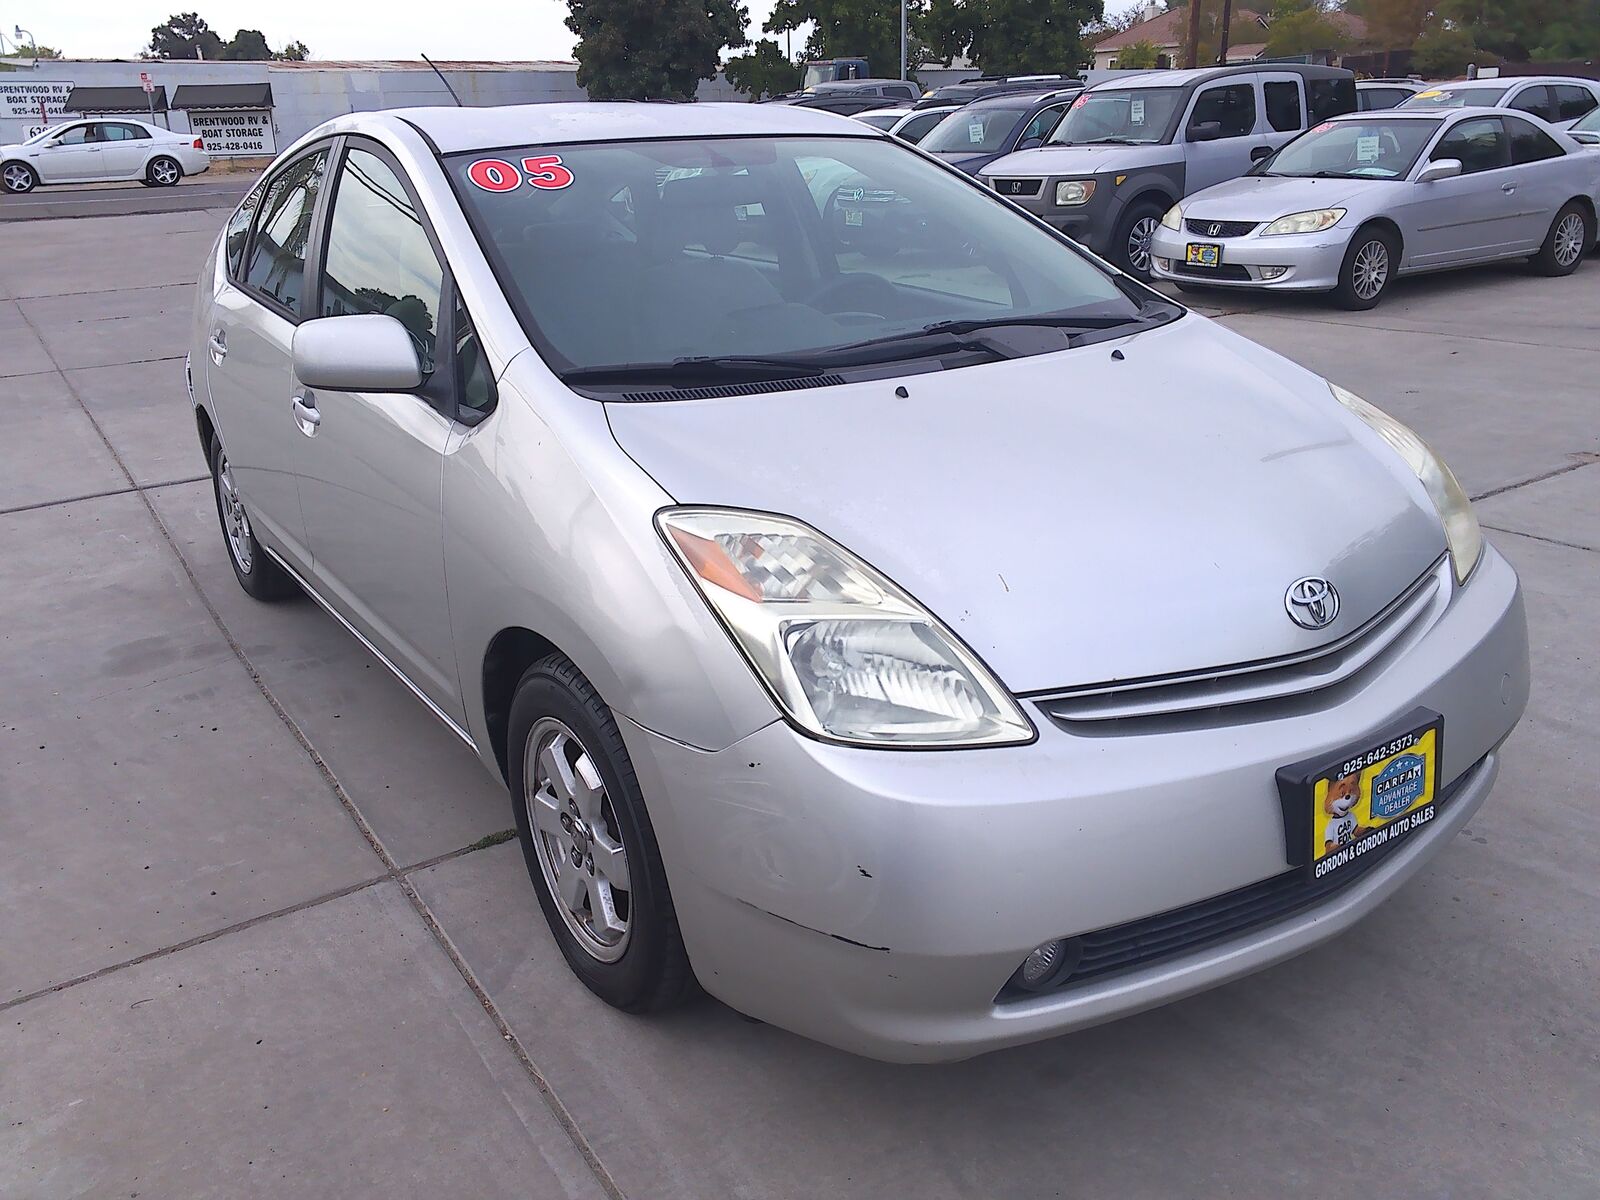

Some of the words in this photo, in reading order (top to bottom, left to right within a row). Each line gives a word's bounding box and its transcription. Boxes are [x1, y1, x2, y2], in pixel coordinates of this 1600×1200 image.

[0, 85, 50, 94] BRENTWOOD
[52, 86, 63, 94] RV
[6, 96, 28, 104] BOAT
[31, 96, 67, 104] STORAGE
[193, 116, 245, 127] BRENTWOOD
[248, 115, 259, 125] RV
[262, 115, 269, 125] &
[202, 129, 223, 138] BOAT
[226, 128, 264, 137] STORAGE
[467, 155, 575, 193] 05
[1343, 734, 1413, 775] 925-642-5373
[1377, 764, 1422, 794] CARFAX
[1378, 781, 1418, 807] ADVANTAGE
[1384, 795, 1411, 815] DEALER
[1338, 820, 1352, 836] CAR
[1315, 849, 1348, 879] GORDON
[1349, 846, 1355, 860] &
[1356, 829, 1388, 857] GORDON
[1389, 819, 1410, 840] AUTO
[1411, 805, 1434, 828] SALES
